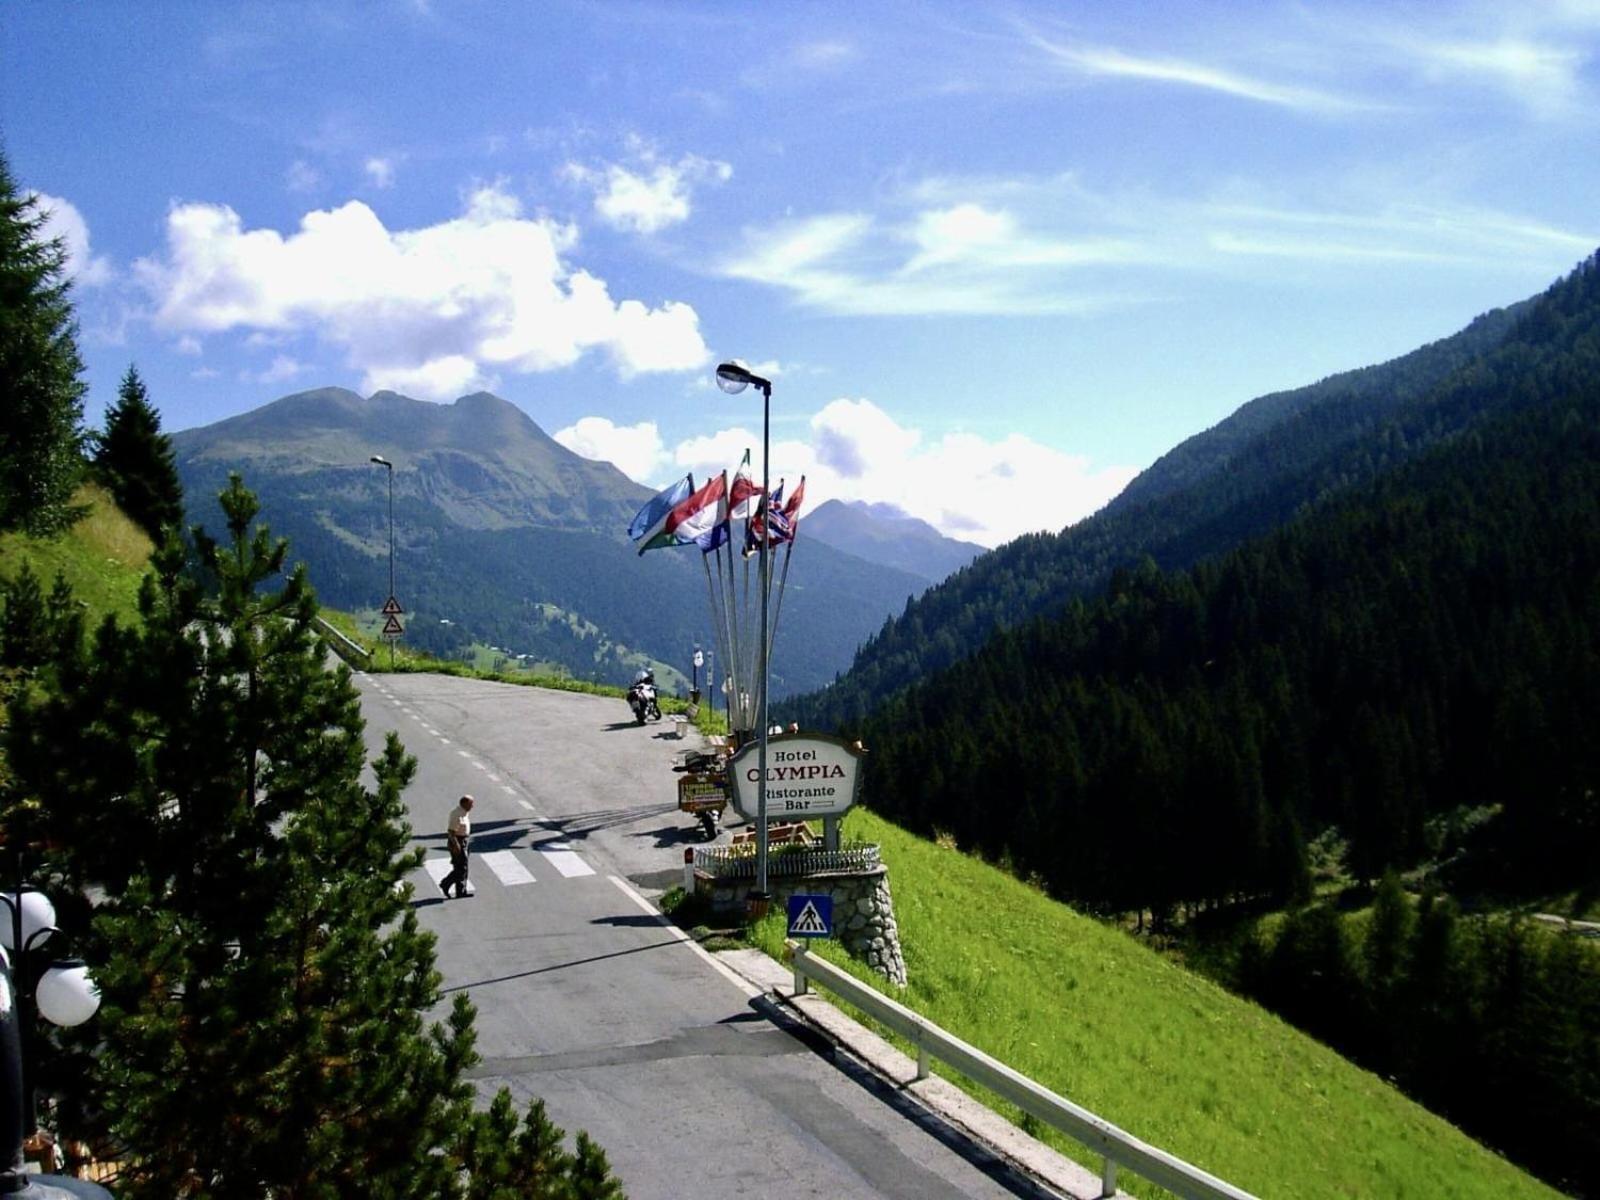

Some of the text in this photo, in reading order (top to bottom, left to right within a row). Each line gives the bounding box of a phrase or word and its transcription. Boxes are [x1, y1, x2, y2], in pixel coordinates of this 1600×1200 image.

[775, 750, 817, 762] Hotel
[746, 765, 846, 783] OLYMPIA
[785, 800, 811, 811] Bar
